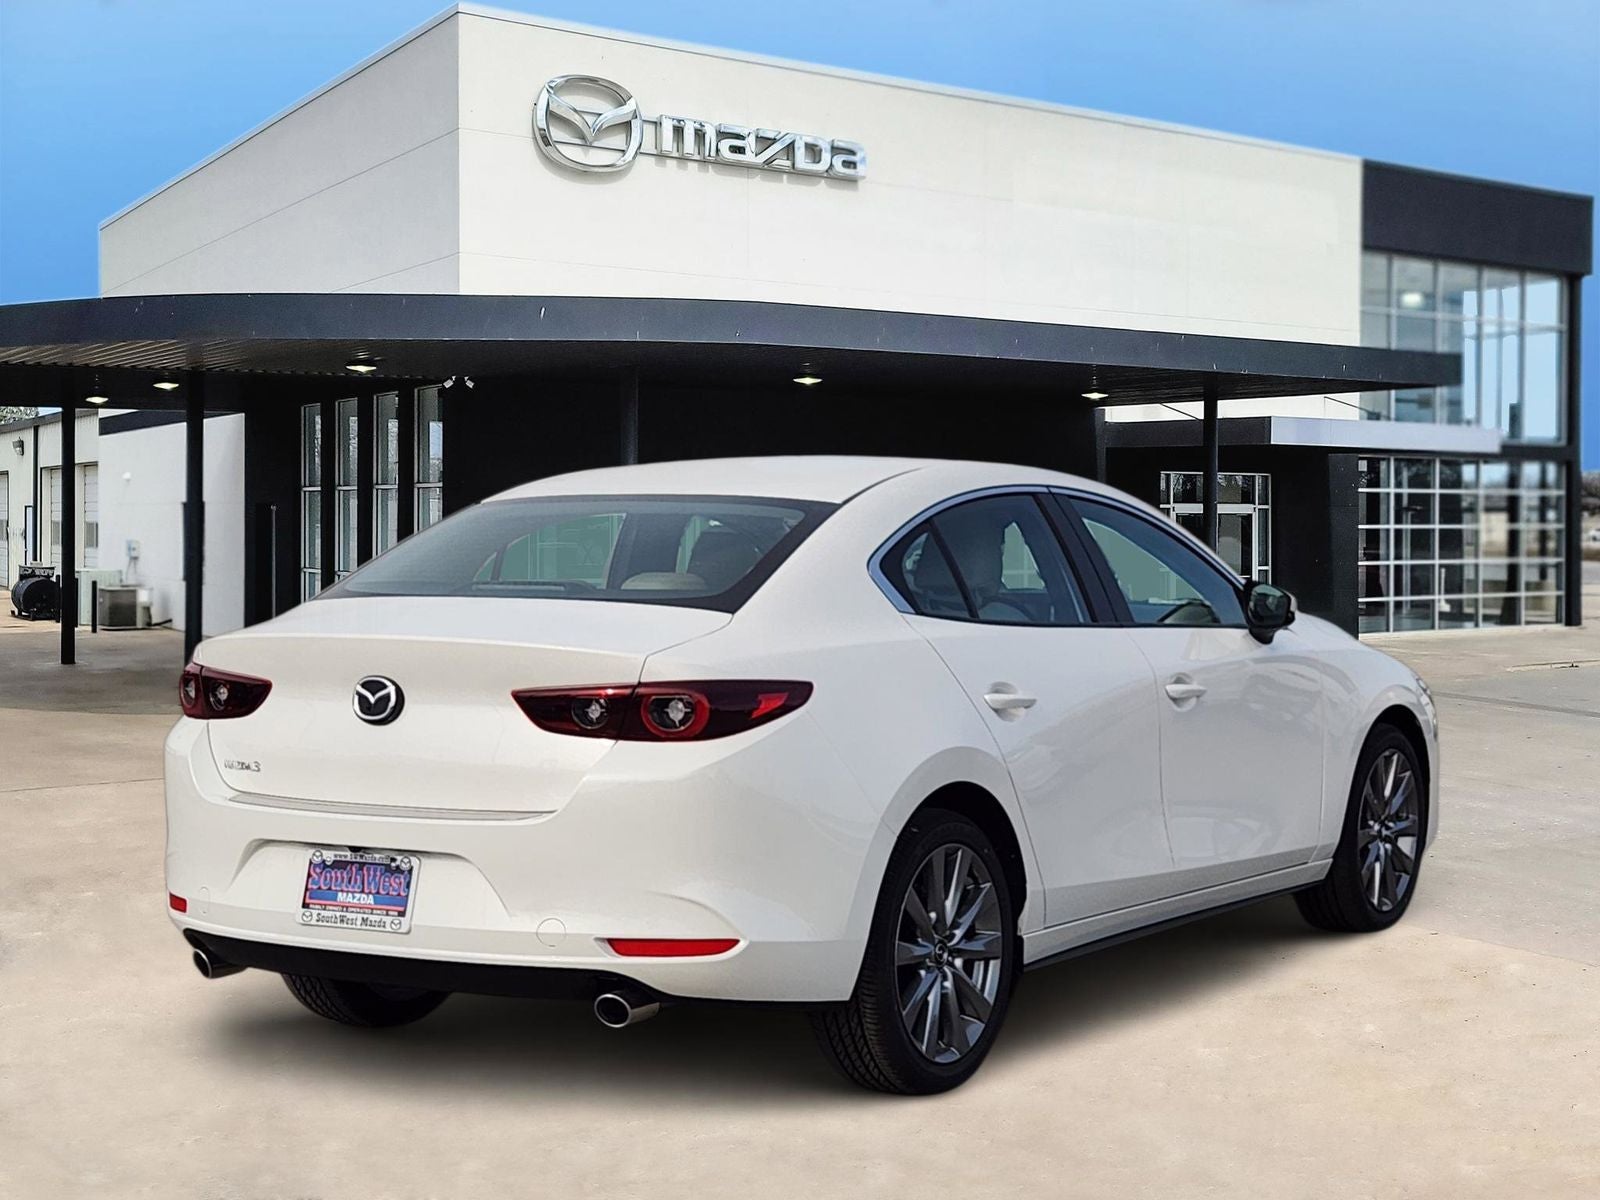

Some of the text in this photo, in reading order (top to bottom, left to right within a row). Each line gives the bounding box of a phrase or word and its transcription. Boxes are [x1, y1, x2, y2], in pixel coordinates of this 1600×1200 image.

[336, 892, 375, 905] MAZDA
[315, 912, 387, 929] SouthWest Mazda
